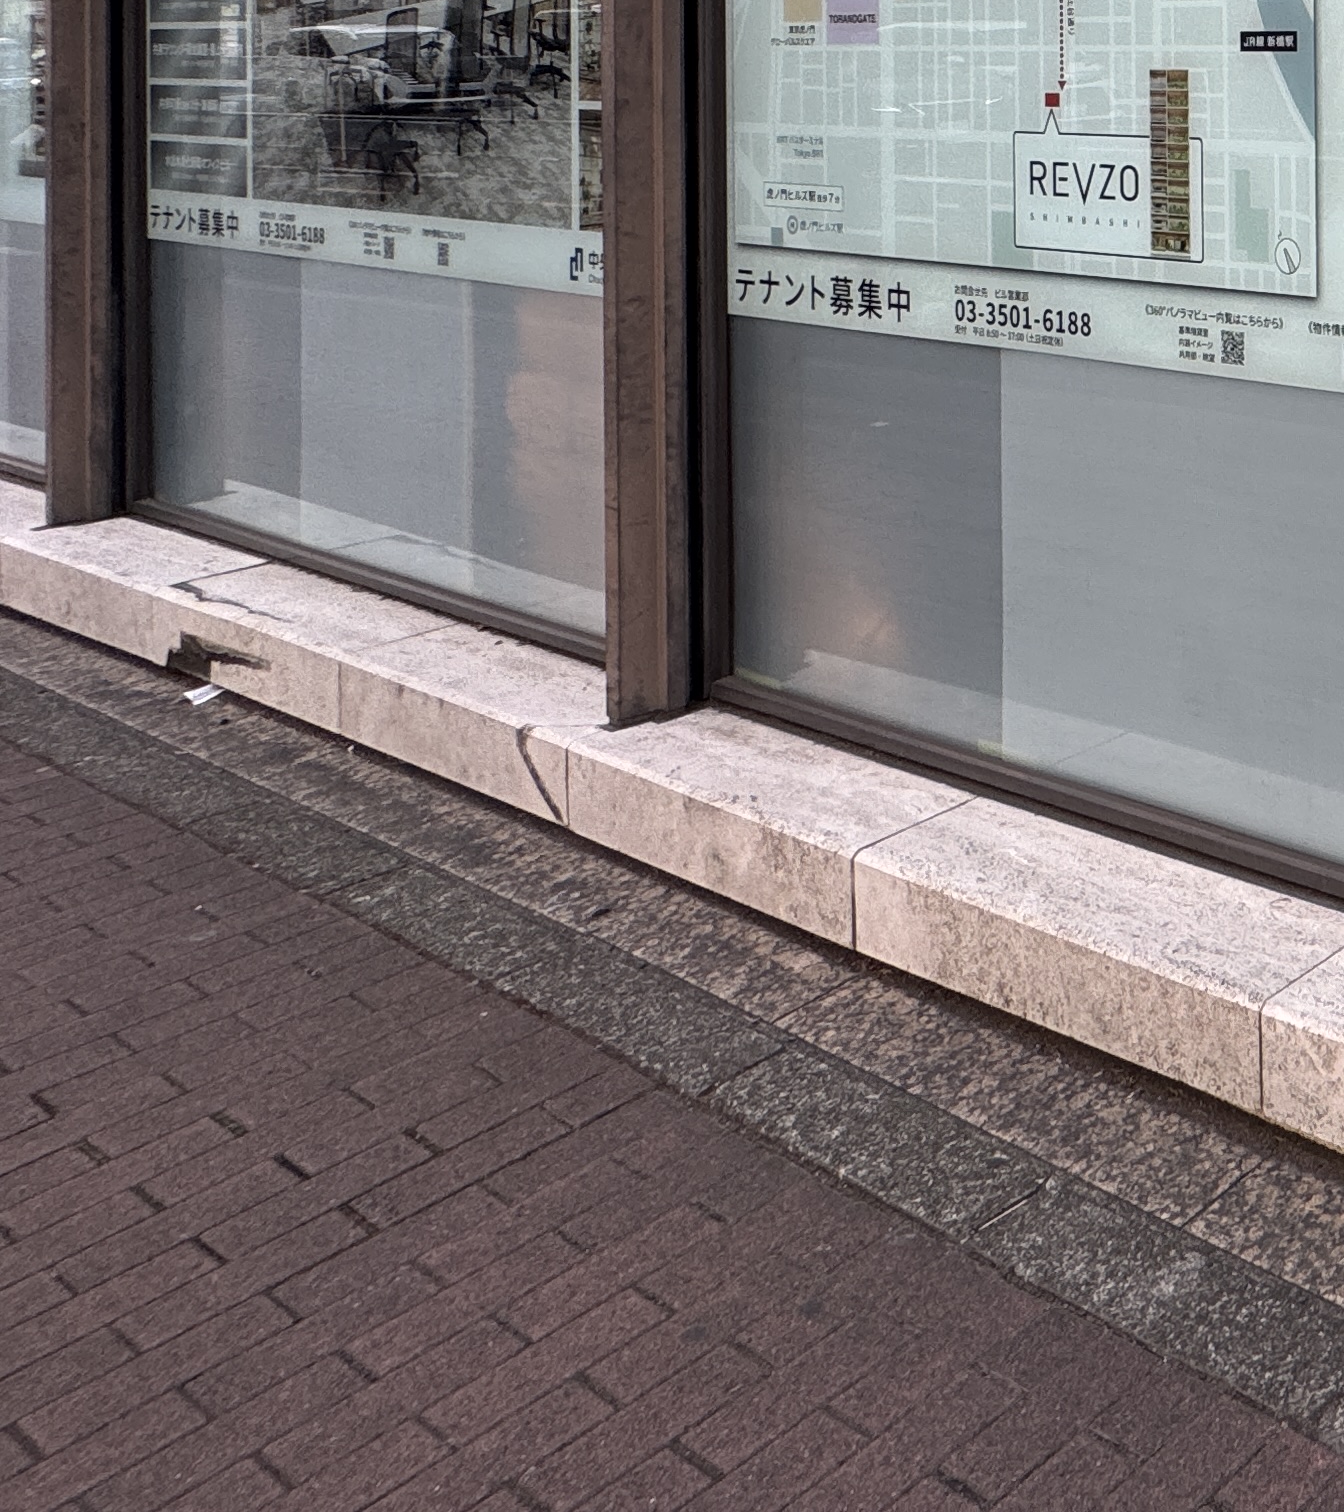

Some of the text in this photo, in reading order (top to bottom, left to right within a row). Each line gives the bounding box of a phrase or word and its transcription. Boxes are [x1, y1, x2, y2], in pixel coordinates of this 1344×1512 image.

[1029, 160, 1140, 206] REVZO
[149, 204, 240, 239] テナント募集中
[258, 220, 326, 245] 03-3501-6188
[1029, 211, 1141, 229] SHIMBASHI
[588, 249, 604, 270] 中
[735, 268, 912, 324] テナント募集中
[954, 298, 1093, 338] 03-3501-6188
